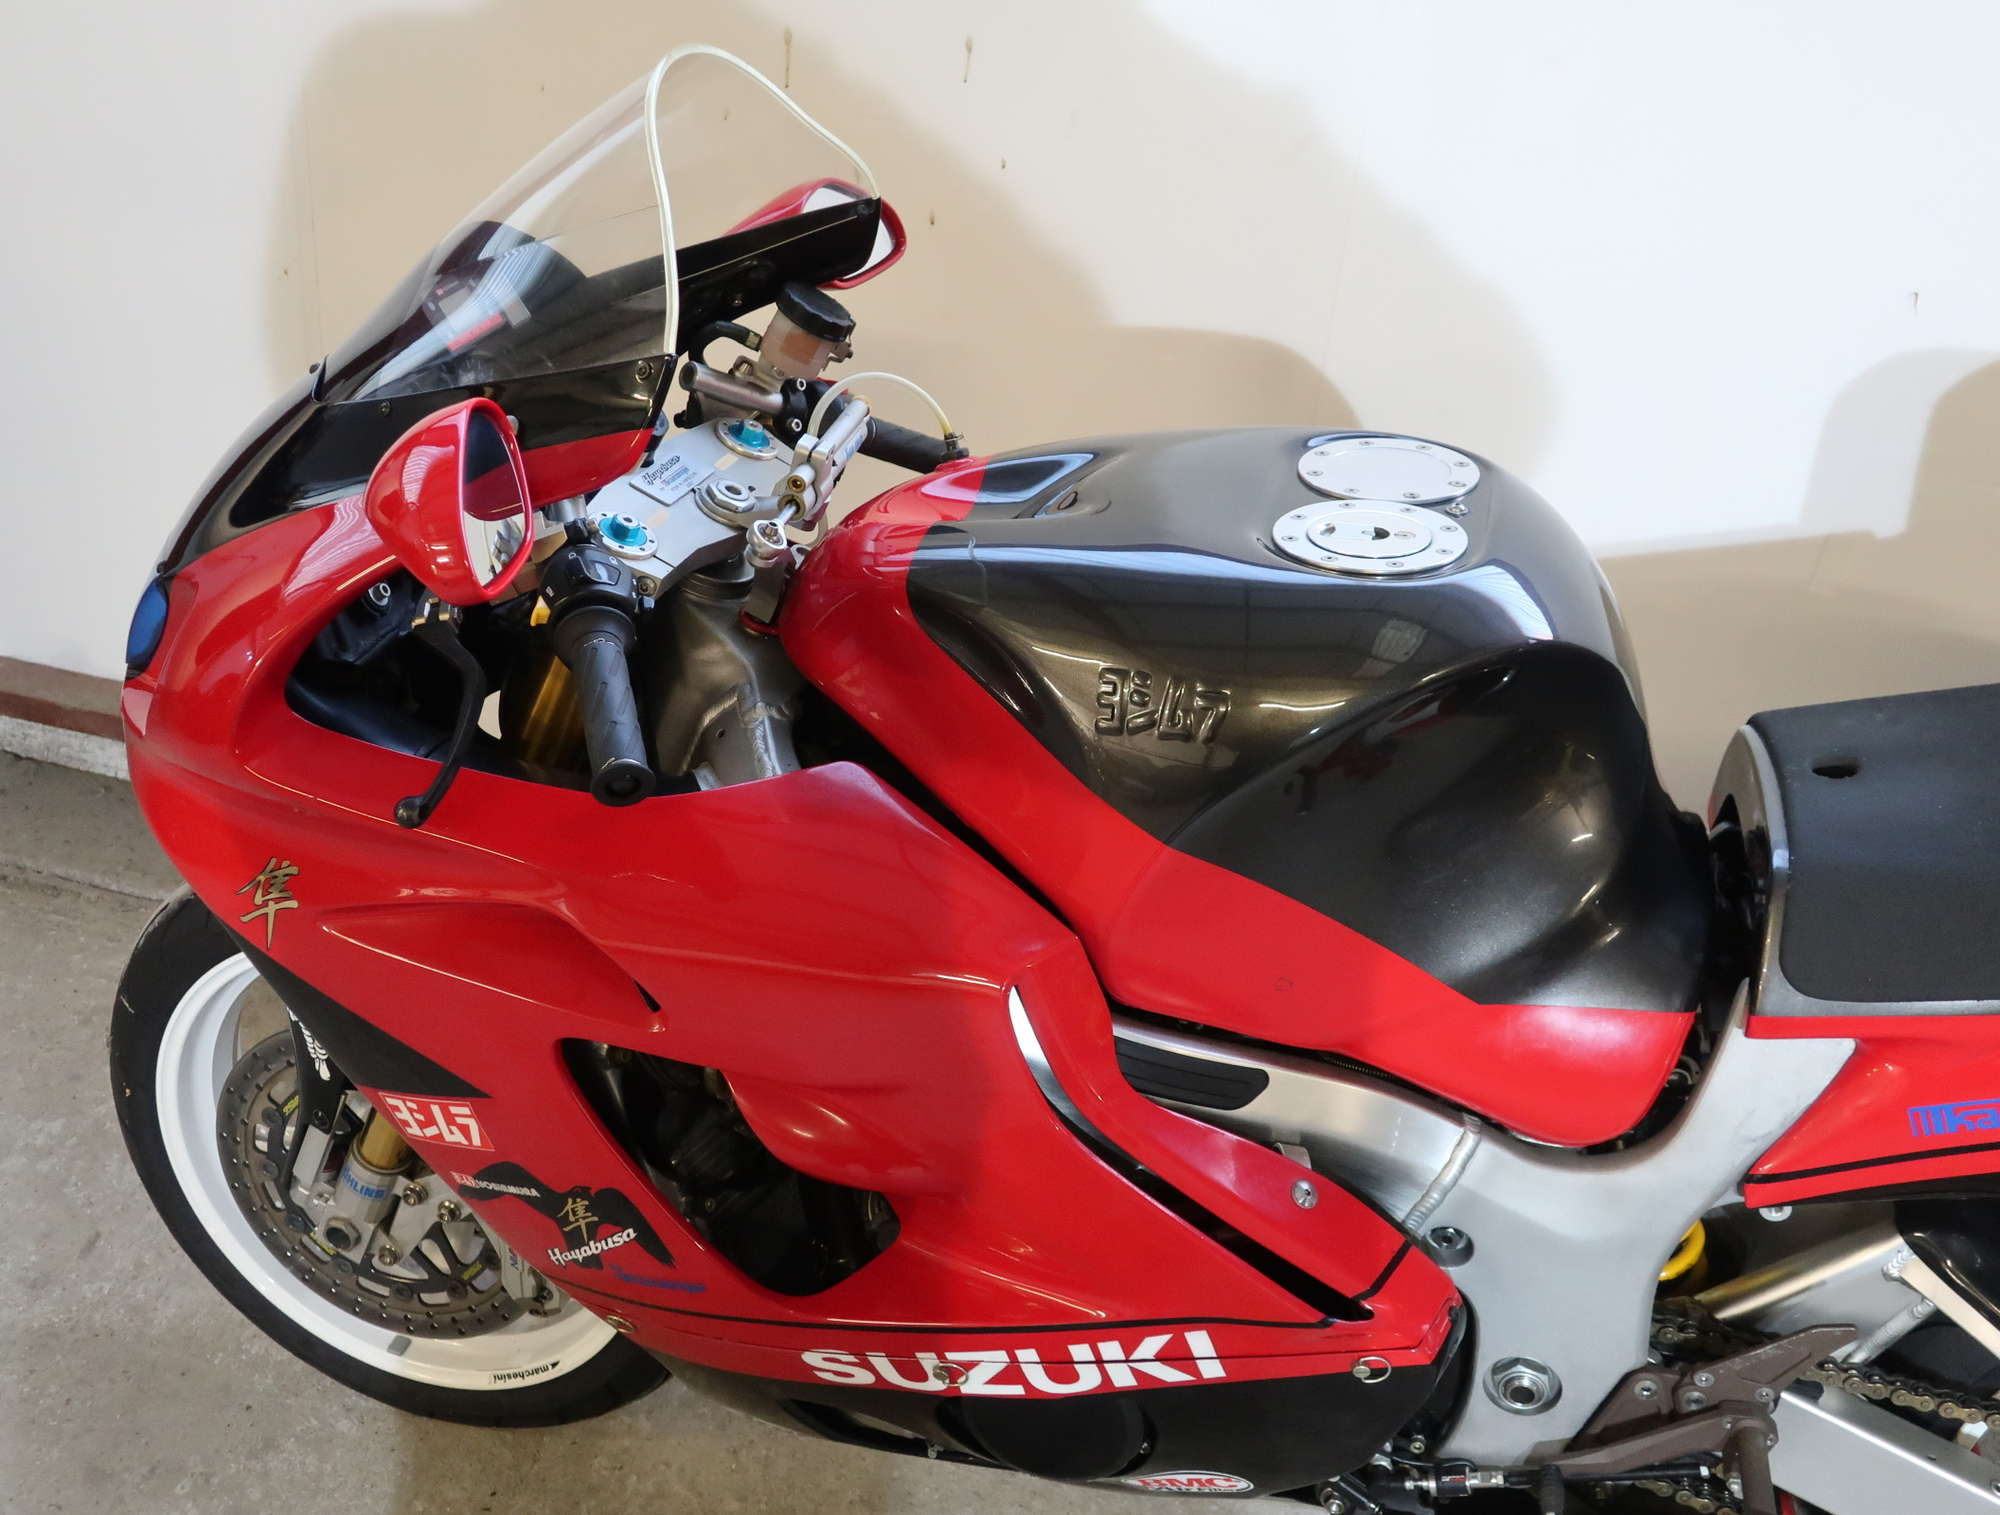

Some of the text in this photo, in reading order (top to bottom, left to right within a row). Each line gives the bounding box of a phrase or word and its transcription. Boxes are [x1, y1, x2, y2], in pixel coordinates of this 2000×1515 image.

[236, 857, 299, 951] 隼
[385, 1097, 481, 1146] ヨシムラ
[557, 1197, 600, 1244] 隼
[547, 1227, 638, 1267] Hayabusa
[800, 1329, 1227, 1396] SUZUKI
